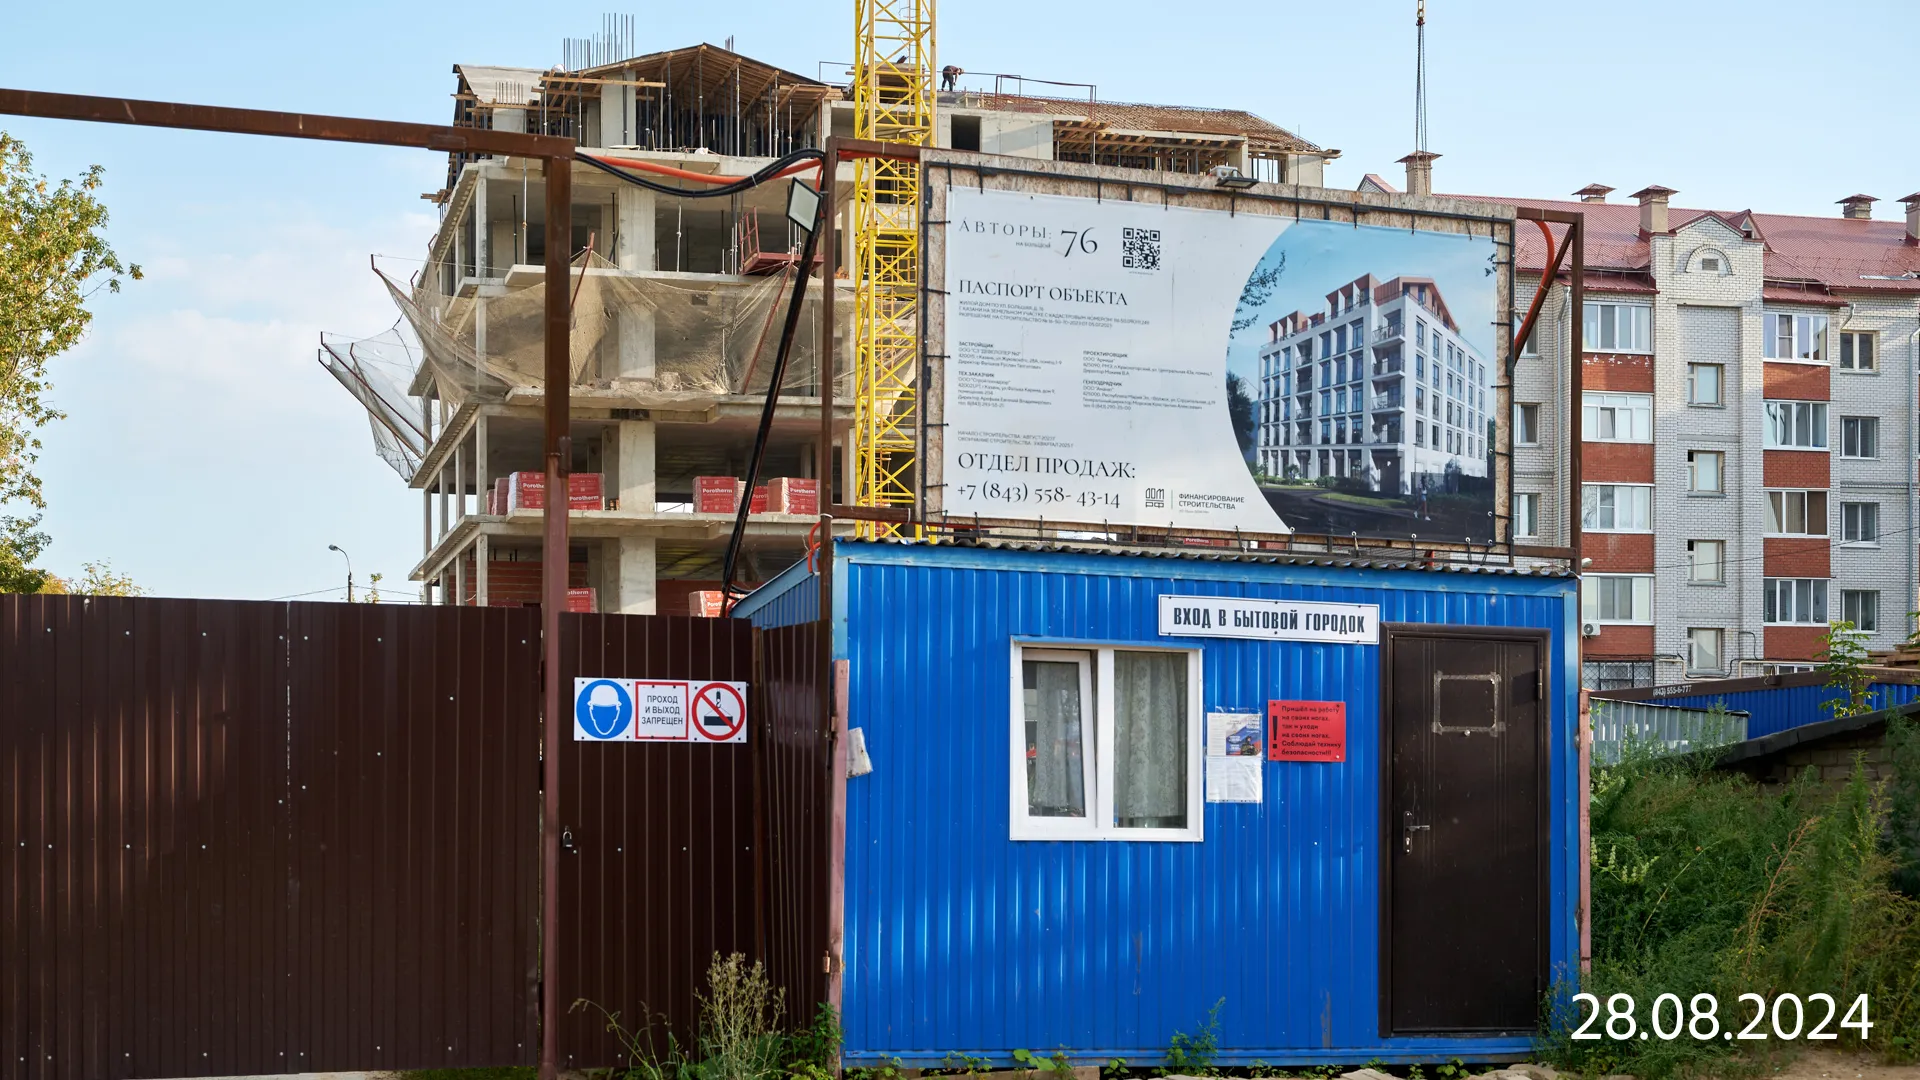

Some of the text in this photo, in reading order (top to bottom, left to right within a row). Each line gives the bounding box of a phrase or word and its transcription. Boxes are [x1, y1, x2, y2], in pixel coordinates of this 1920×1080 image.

[1060, 227, 1098, 258] 76
[960, 279, 1128, 306] ПАСПОРТ ОБЪЕКТА
[1082, 350, 1128, 358] ПРОЕКТИРОВЩИК
[1082, 379, 1122, 387] ГЕНПОДРЯДЧИК
[958, 452, 1135, 478] ОТДЕЛ ПРОДАЖ:
[957, 484, 976, 500] +7
[982, 480, 1028, 503] (843)
[1076, 491, 1120, 509] 43-14
[1178, 493, 1245, 503] ФИНАНСИРОВАНИЕ
[1178, 500, 1236, 510] СТРОИТЕЛЬСТВА
[1173, 607, 1365, 635] ВХОД В БЫТОВОЙ ГОРОДОК
[646, 695, 678, 705] ПРОХОД
[644, 706, 680, 715] И ВЫХОД
[1281, 705, 1308, 713] Пришёл
[641, 716, 683, 726] ЗАПРЕЩЕН
[1281, 740, 1316, 748] Соблюдай
